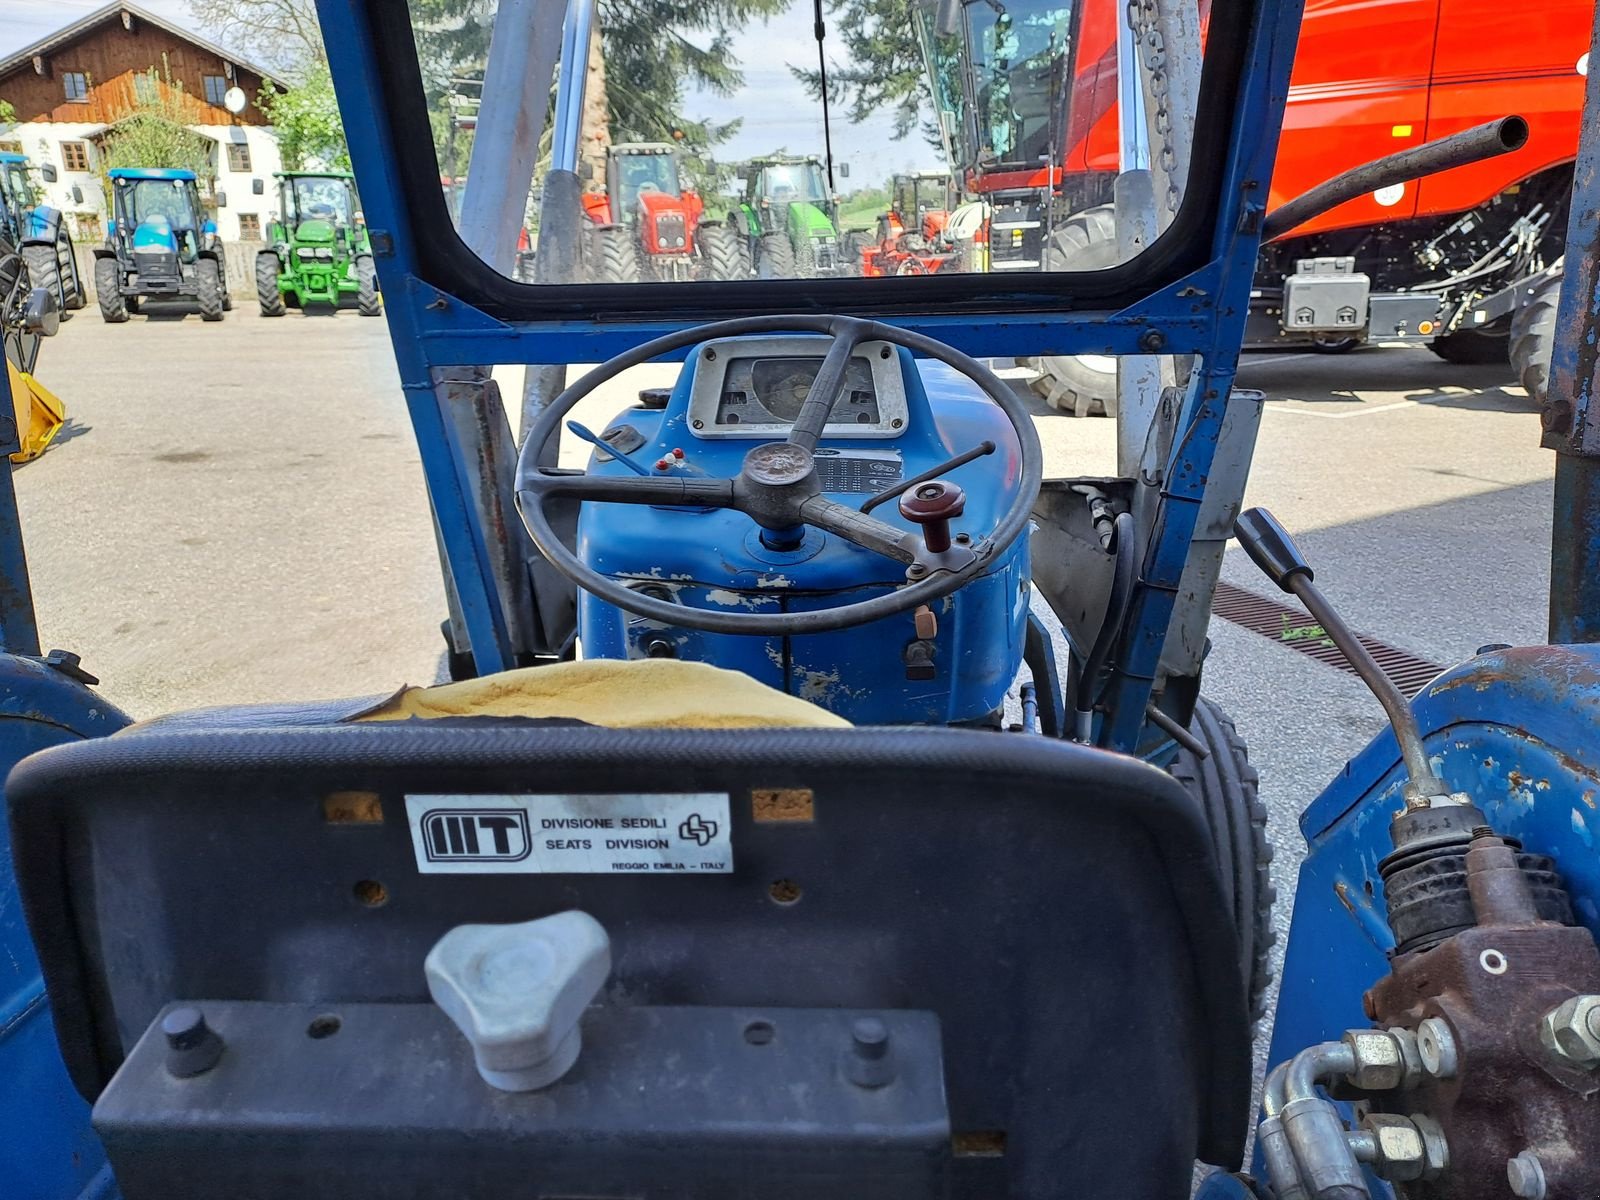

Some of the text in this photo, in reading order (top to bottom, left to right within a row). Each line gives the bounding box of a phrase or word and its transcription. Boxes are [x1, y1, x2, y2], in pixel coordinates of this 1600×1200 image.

[541, 818, 667, 829] DIVISIONE SEDILI
[545, 839, 670, 850] SEATS DIVISION
[612, 862, 649, 870] REGGIO
[653, 862, 686, 870] EMILIA
[700, 862, 726, 870] ITALY
